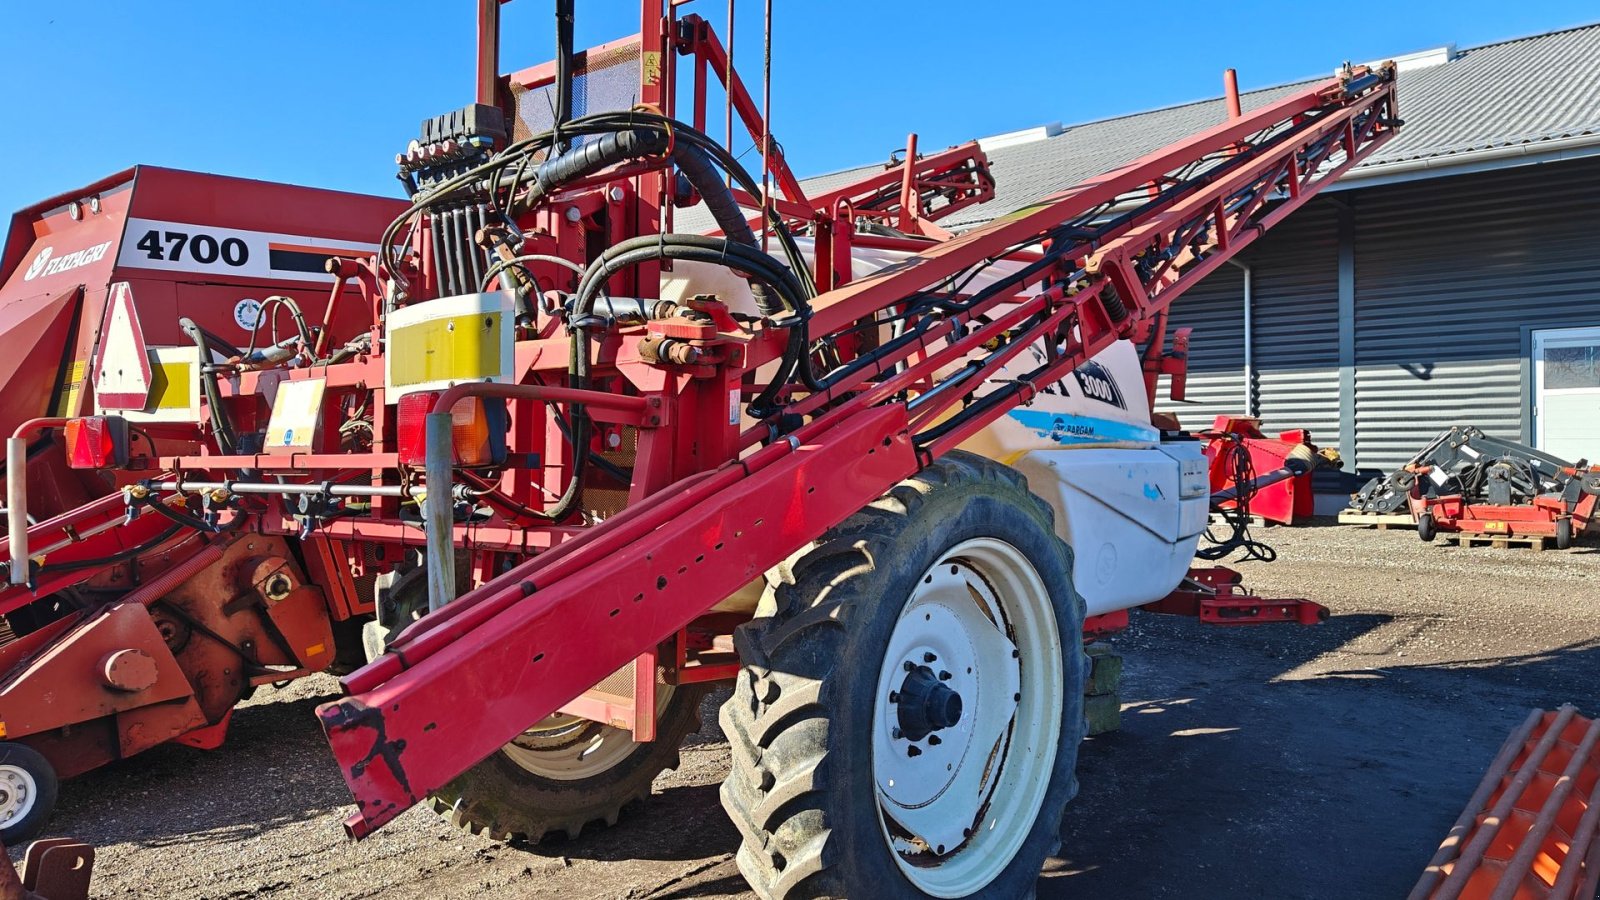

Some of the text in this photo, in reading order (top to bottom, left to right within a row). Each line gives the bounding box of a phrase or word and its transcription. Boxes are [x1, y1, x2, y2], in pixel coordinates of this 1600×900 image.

[39, 240, 113, 278] FIATAGRI
[136, 229, 250, 267] 4700
[1080, 372, 1113, 402] 3000
